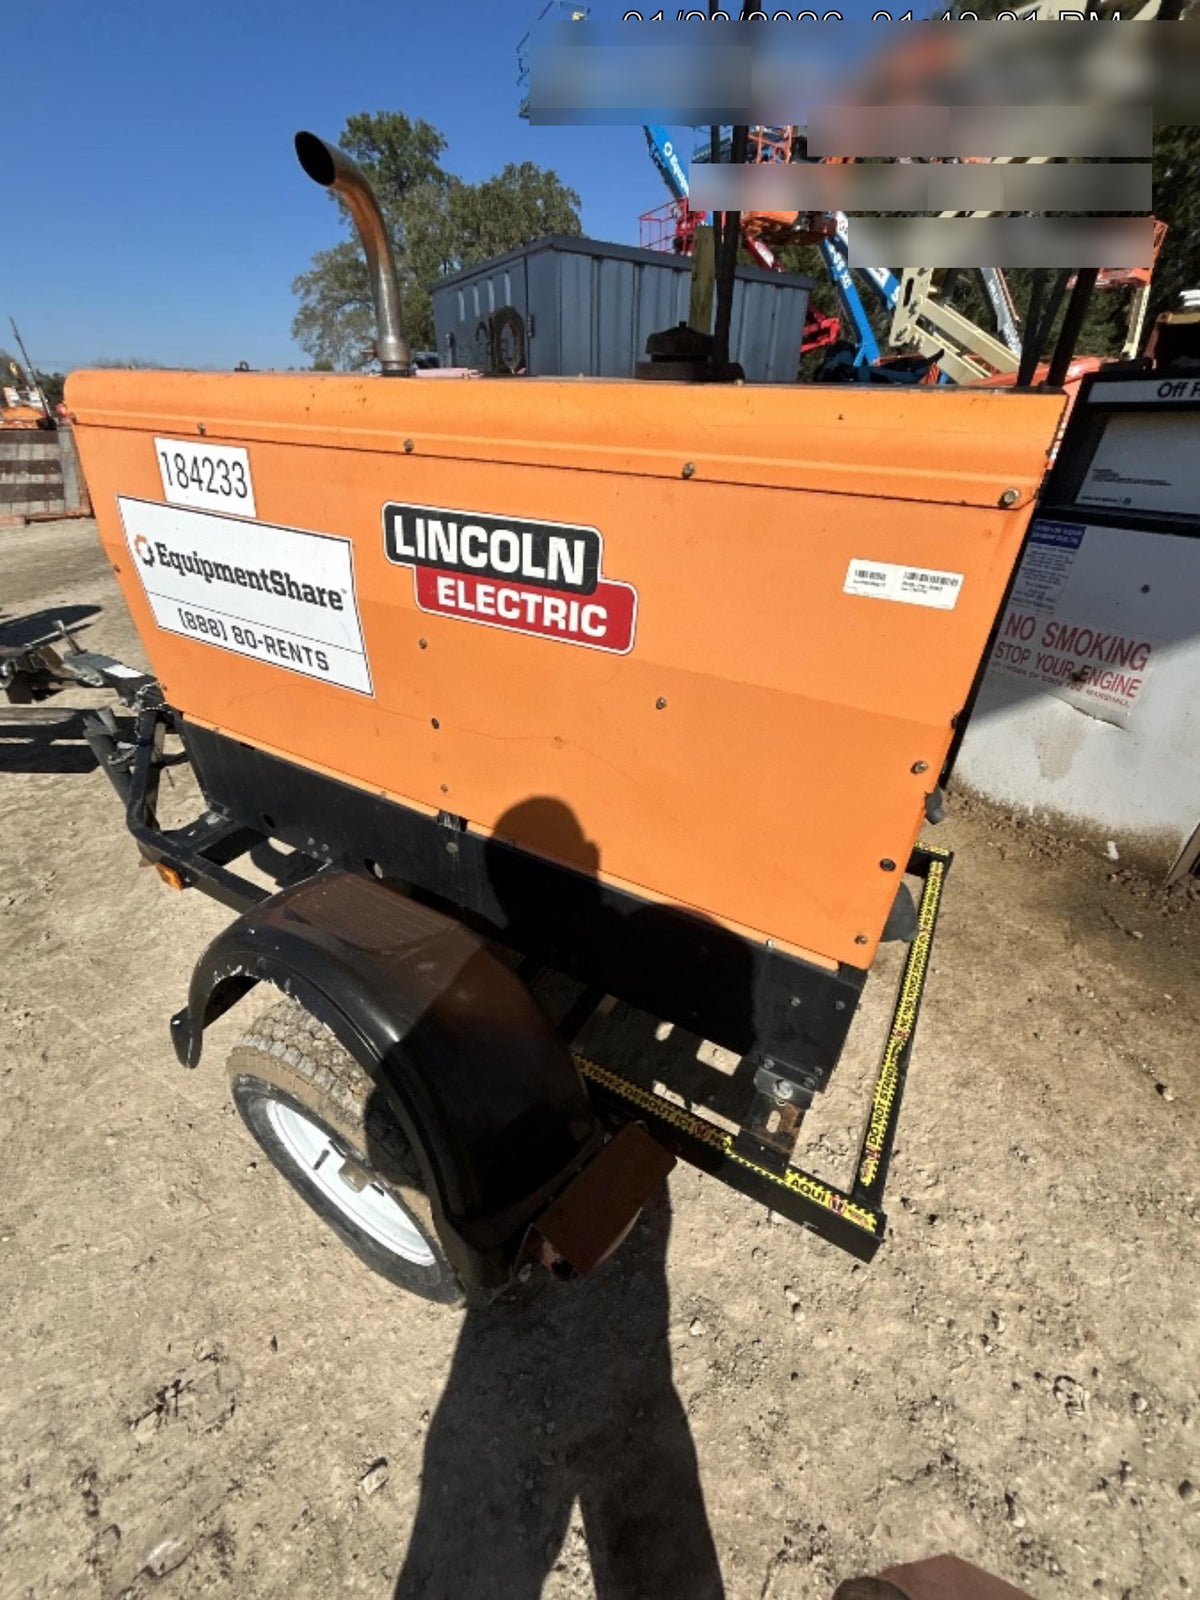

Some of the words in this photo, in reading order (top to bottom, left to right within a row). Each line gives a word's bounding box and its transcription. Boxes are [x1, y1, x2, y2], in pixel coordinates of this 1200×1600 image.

[1157, 381, 1189, 399] Off
[160, 451, 249, 499] 184233
[155, 542, 344, 612] EquipmentShare
[393, 514, 586, 586] LINCOLN
[436, 575, 609, 639] ELECTRIC
[178, 607, 229, 642] (888)
[231, 624, 330, 672] 80-RENTS
[994, 641, 1032, 664] STOP
[1036, 651, 1075, 680] YOUR
[1078, 664, 1143, 699] ENGINE
[1004, 612, 1037, 641] NO
[1042, 621, 1152, 672] SMOKING
